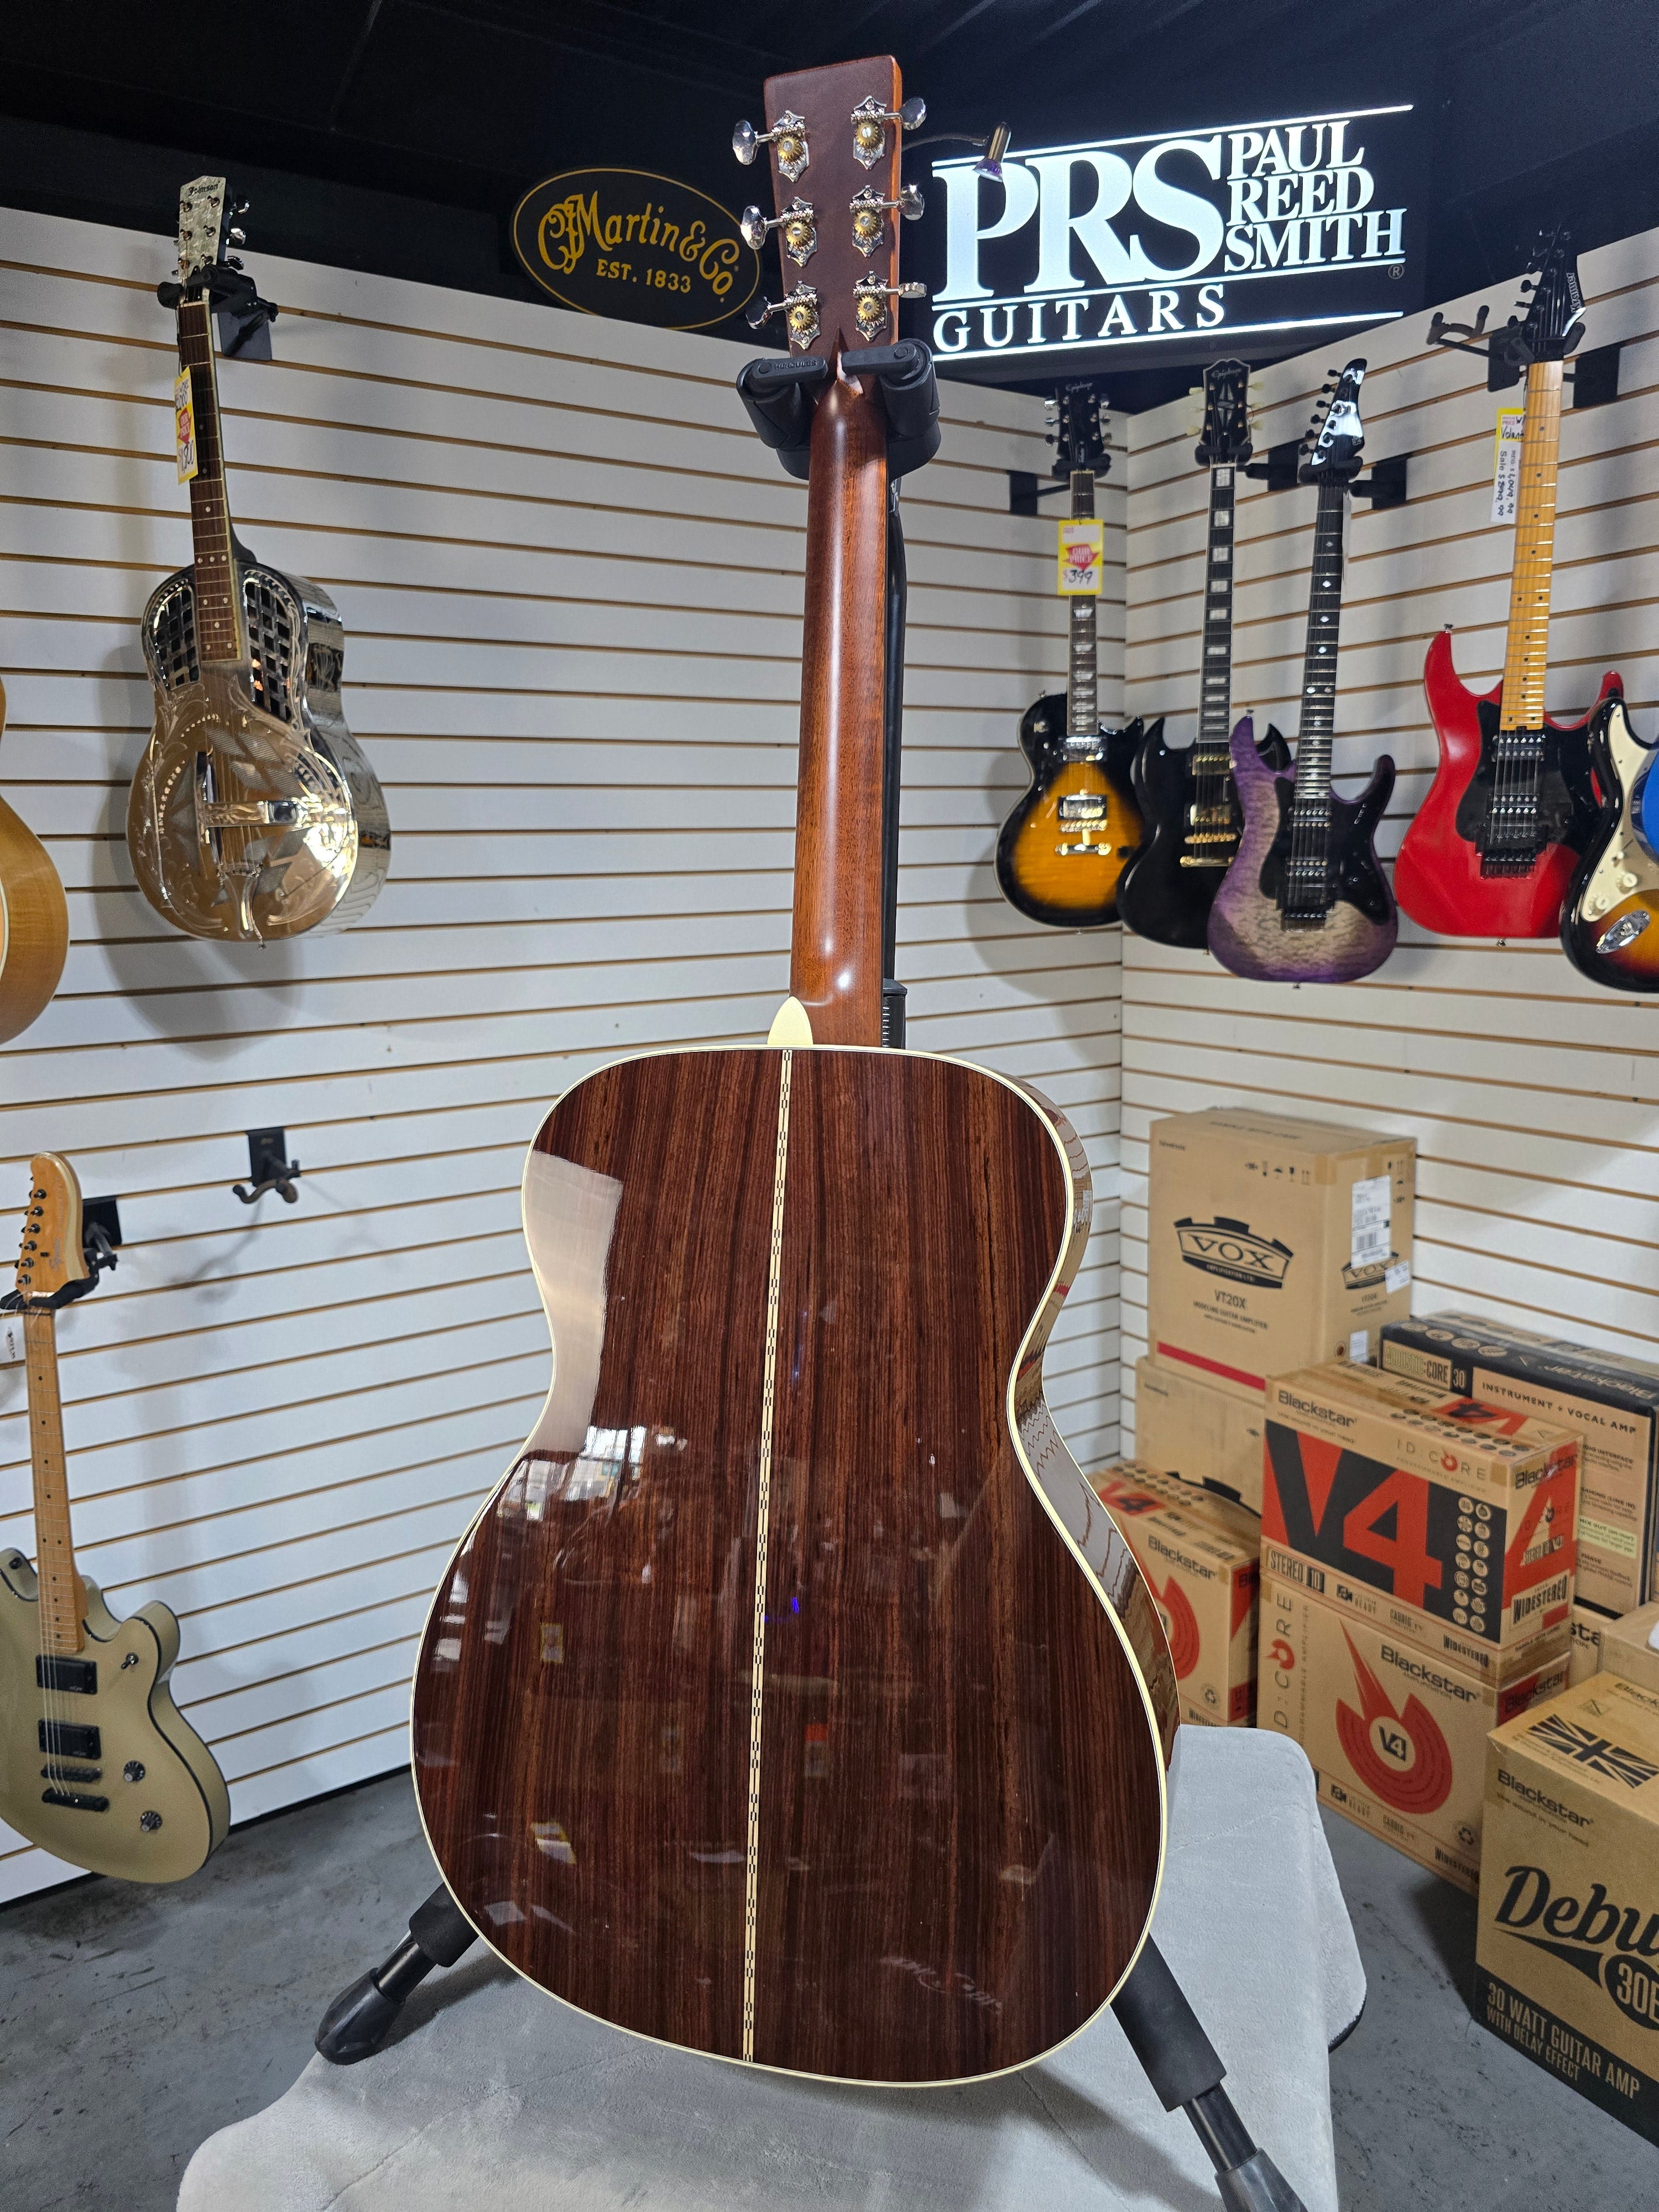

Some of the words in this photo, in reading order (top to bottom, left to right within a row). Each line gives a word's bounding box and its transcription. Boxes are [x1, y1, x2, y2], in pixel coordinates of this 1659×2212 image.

[1227, 121, 1365, 180] PAUL
[188, 184, 218, 196] Johnson
[1226, 167, 1375, 226] REED
[932, 135, 1224, 302] PRS
[1224, 208, 1407, 273] SMITH
[597, 259, 637, 283] EST.
[646, 268, 691, 293] 1833
[1566, 272, 1581, 314] Kramer
[932, 284, 1225, 352] GUITARS
[775, 360, 817, 369] HERCULES
[1070, 554, 1093, 563] PRICE
[1188, 1233, 1274, 1272] VOX
[1214, 1290, 1246, 1309] VT20X
[1453, 1368, 1465, 1389] 30
[1278, 1389, 1355, 1428] Blackstar
[1481, 1383, 1553, 1410] INSTRUMENT
[1567, 1407, 1605, 1426] VOCAL
[1610, 1421, 1636, 1434] AMP
[1515, 1453, 1579, 1489] Blackstar
[1264, 1418, 1442, 1609] V4
[1148, 1533, 1217, 1580] Blackstar
[1271, 1551, 1303, 1582] STEREO
[1381, 1644, 1478, 1703] Blackstar
[1505, 1671, 1565, 1714] Blackstar
[1378, 1725, 1407, 1762] V4
[1498, 1768, 1592, 1828] Blackstar
[1494, 1866, 1659, 1957] Debu
[1486, 2005, 1511, 2034] WITH
[1514, 2023, 1543, 2056] DELAY
[1546, 2046, 1580, 2081] EFFECT
[1488, 1981, 1505, 2011] 30
[1509, 1995, 1547, 2039] WATT
[1551, 2024, 1602, 2078] GUITAR
[1604, 2062, 1640, 2099] AMP
